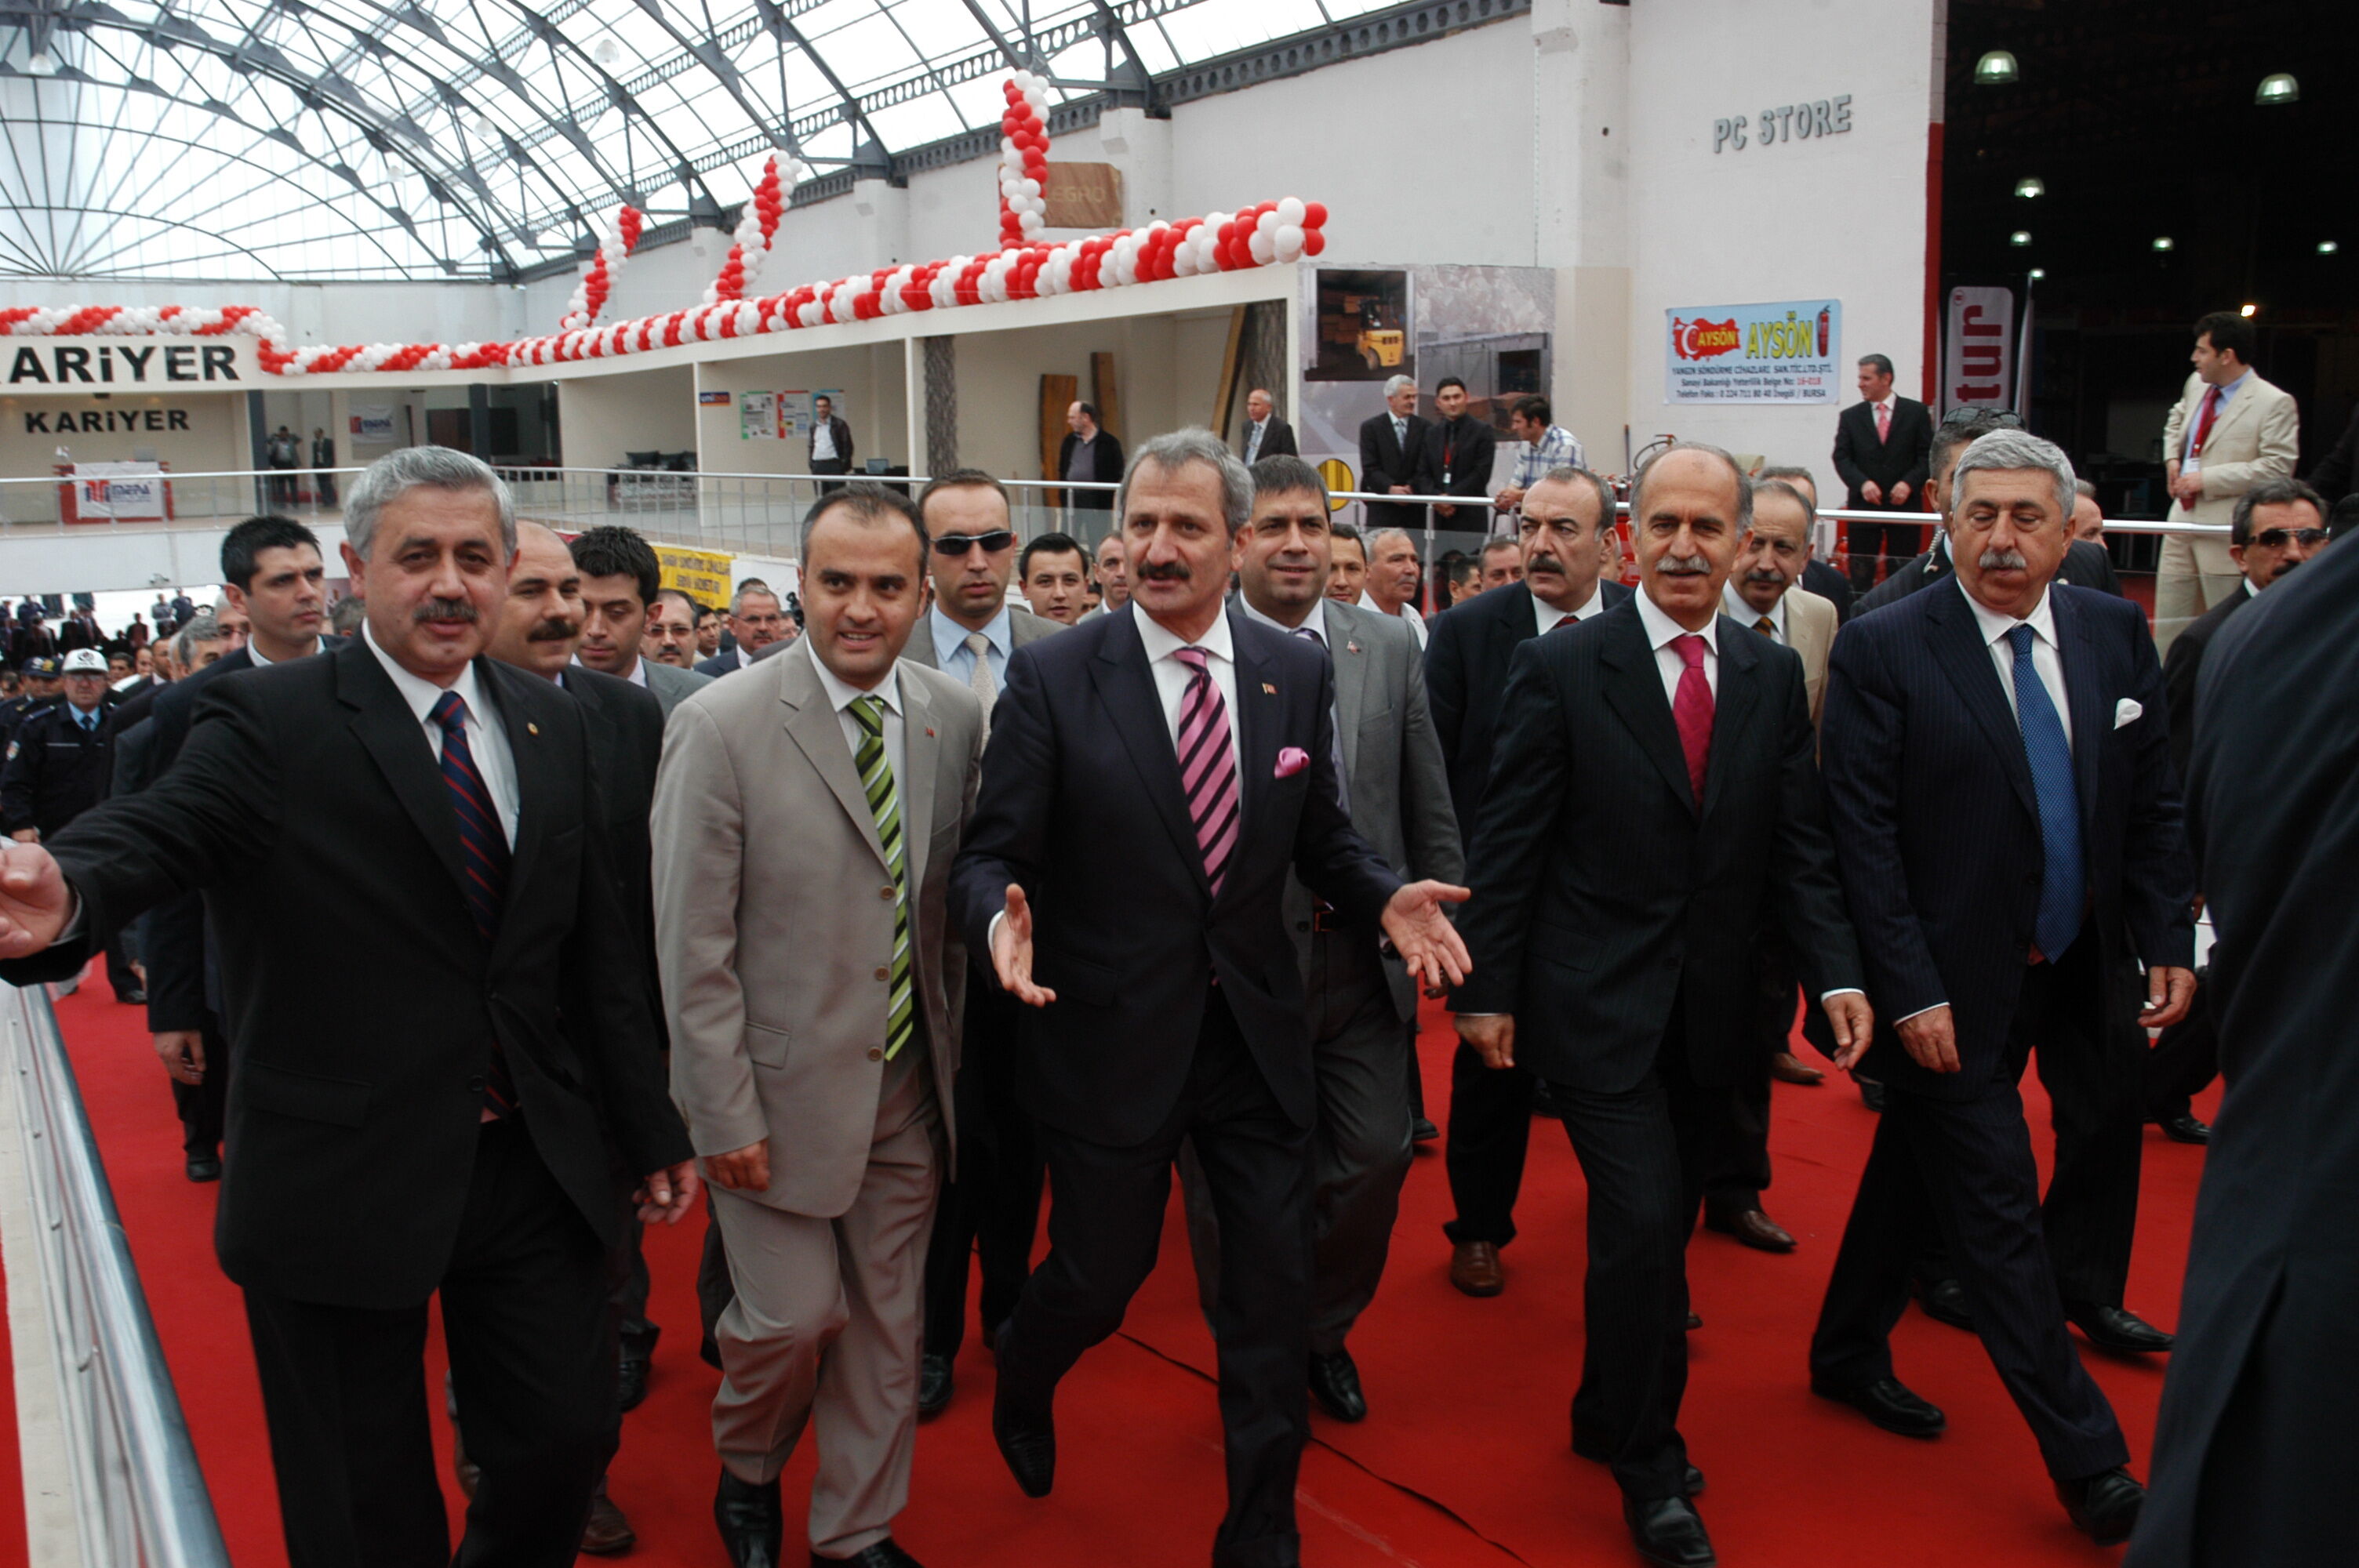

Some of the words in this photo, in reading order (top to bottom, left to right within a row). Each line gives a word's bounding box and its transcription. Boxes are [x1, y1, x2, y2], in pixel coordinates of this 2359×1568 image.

[1714, 115, 1747, 154] PC
[1757, 94, 1852, 145] STORE
[1698, 327, 1737, 347] AYSÖN
[1746, 310, 1813, 359] AYSÖN
[0, 345, 241, 383] ARiYER
